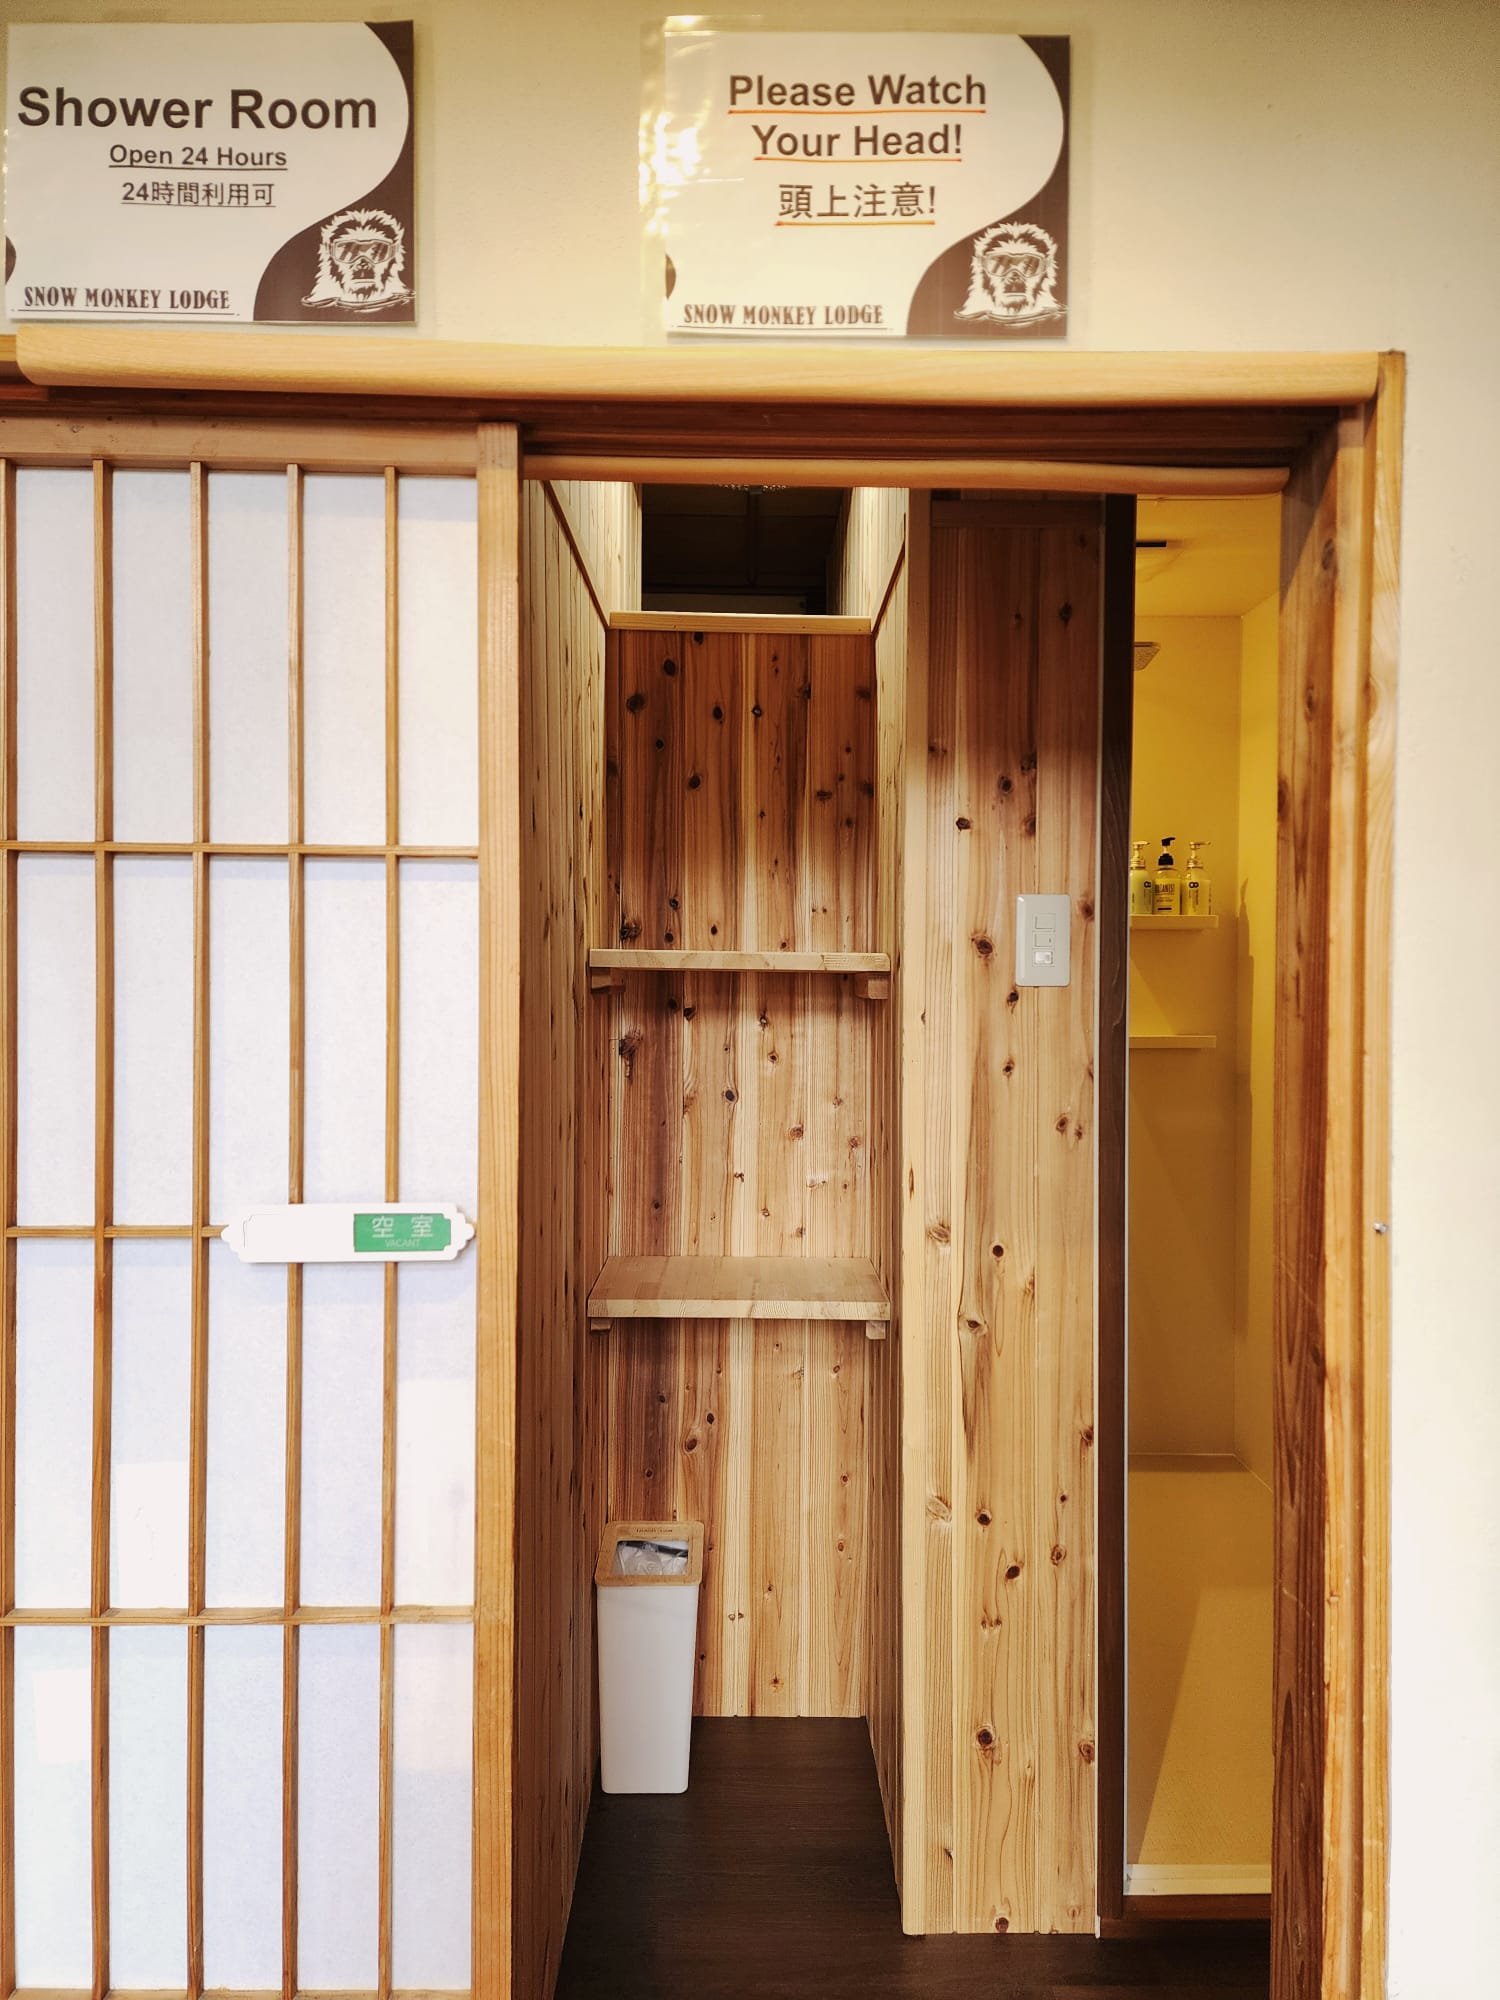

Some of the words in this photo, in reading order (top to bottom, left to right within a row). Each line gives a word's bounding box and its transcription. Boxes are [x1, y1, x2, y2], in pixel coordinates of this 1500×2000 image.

[728, 75, 856, 106] Please
[868, 74, 986, 105] Watch
[18, 86, 213, 128] Shower
[230, 89, 377, 129] Room
[752, 124, 841, 157] Your
[854, 124, 962, 156] Head!
[109, 144, 172, 166] Open
[182, 147, 209, 165] 24
[217, 148, 287, 167] Hours
[122, 181, 275, 206] 24時間利用可
[778, 181, 936, 219] 頭上注意!
[24, 286, 77, 308] SNOW
[85, 288, 162, 309] MONKEY
[169, 290, 230, 310] LODGE
[683, 304, 736, 325] SNOW
[743, 305, 816, 326] MONKEY
[824, 305, 884, 325] LODGE
[384, 1239, 421, 1248] VACANT
